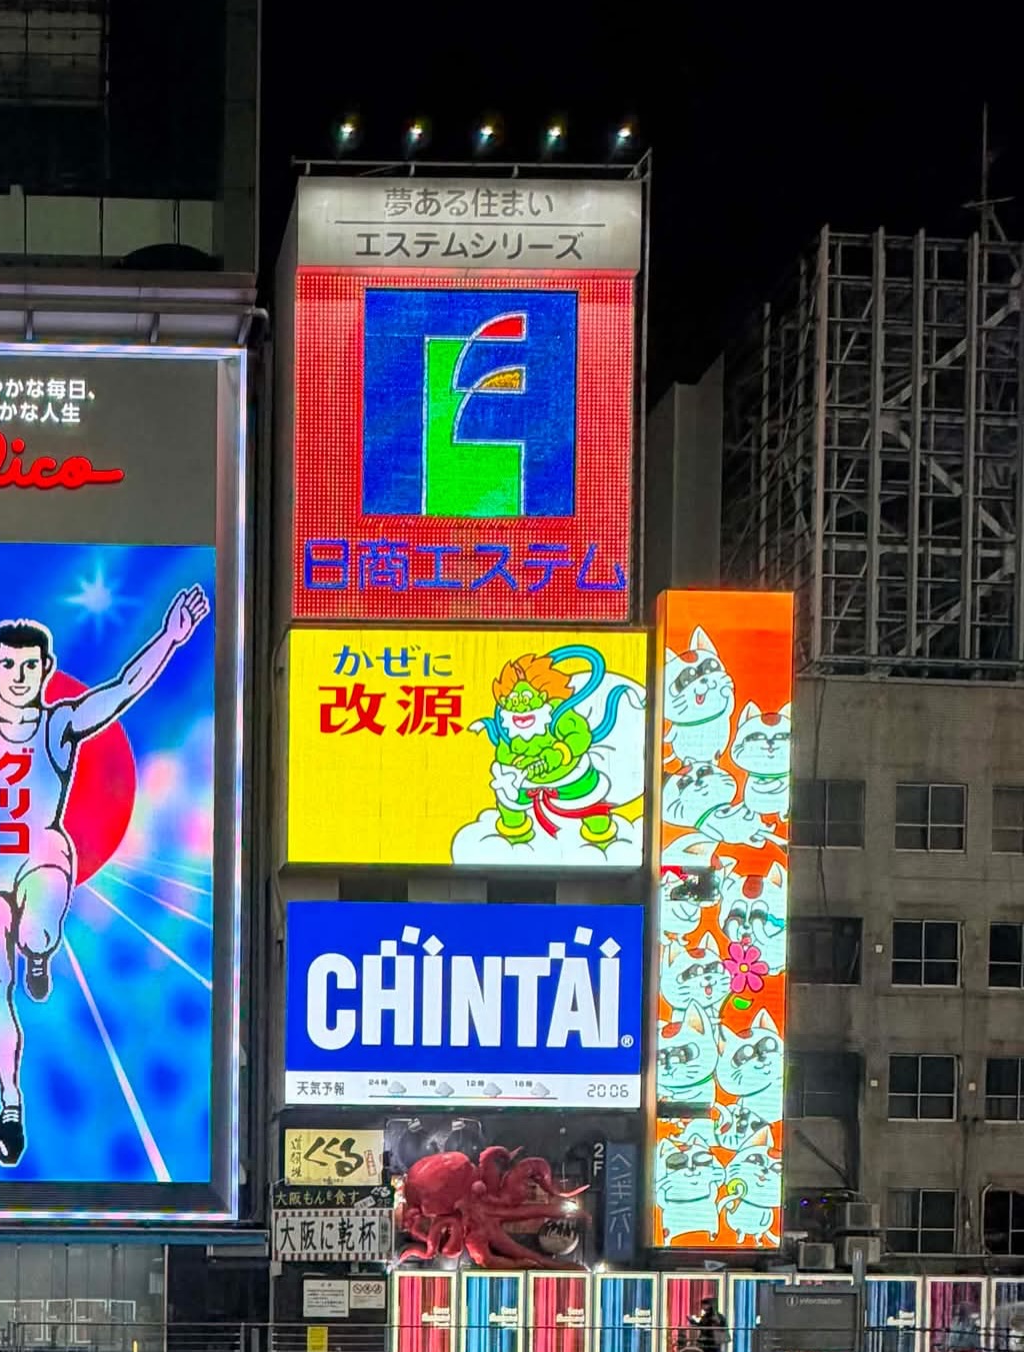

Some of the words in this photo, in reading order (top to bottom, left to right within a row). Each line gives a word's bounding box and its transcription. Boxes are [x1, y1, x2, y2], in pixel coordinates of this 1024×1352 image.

[384, 187, 554, 218] 夢ある住まい
[355, 231, 585, 261] エステムシリーズ
[303, 537, 628, 592] 日商エステム
[332, 644, 454, 678] かぜに
[318, 683, 465, 737] 改源
[307, 925, 622, 1050] CHINTAI
[296, 1081, 345, 1096] 天気予報
[303, 1136, 365, 1177] くくる
[279, 1217, 377, 1251] 大阪に乾杯
